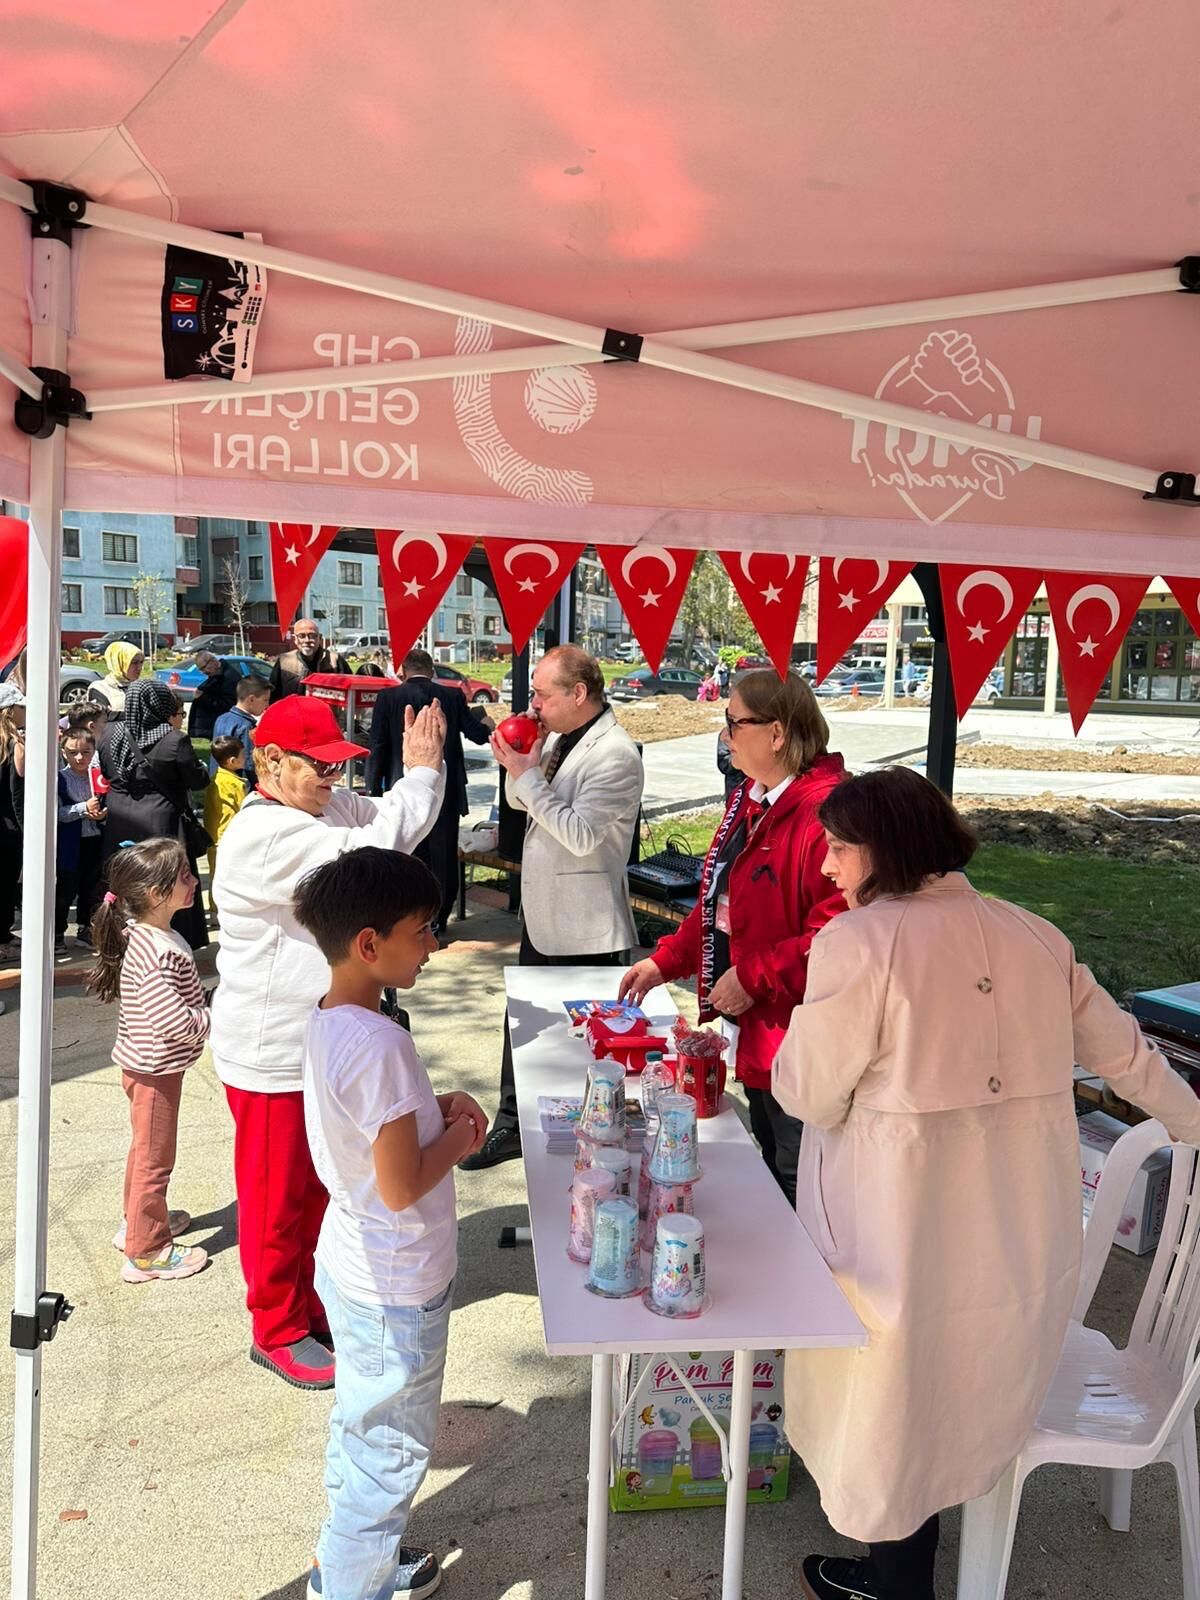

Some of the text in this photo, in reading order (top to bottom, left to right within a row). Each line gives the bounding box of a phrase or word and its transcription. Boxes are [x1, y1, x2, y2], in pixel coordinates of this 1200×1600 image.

[716, 788, 744, 841] TOMMY
[700, 935, 715, 994] TOMMY
[721, 1356, 775, 1382] Pm
